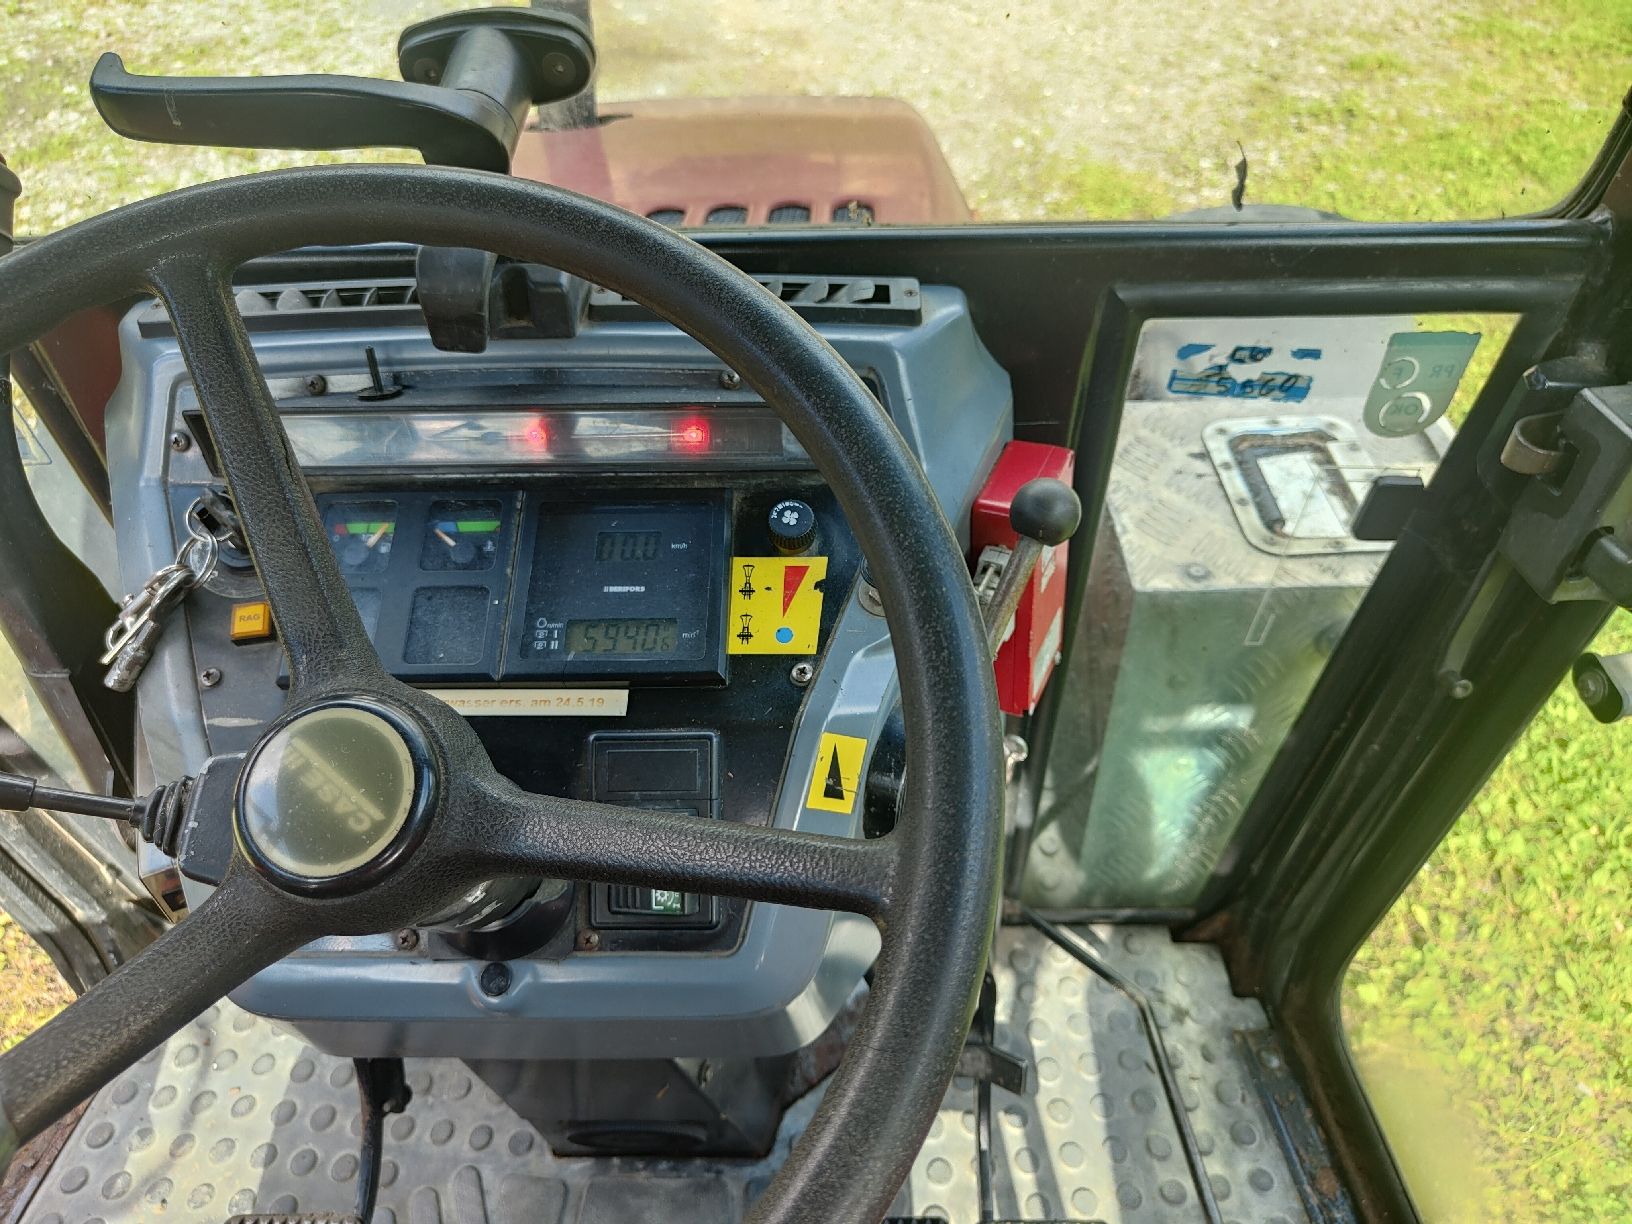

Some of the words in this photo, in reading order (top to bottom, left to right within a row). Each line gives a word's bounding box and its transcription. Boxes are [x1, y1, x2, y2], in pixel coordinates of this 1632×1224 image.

[670, 542, 688, 550] km/h
[239, 613, 261, 623] RAG
[445, 698, 497, 708] wasser
[530, 698, 552, 708] am
[302, 767, 372, 833] CASE
